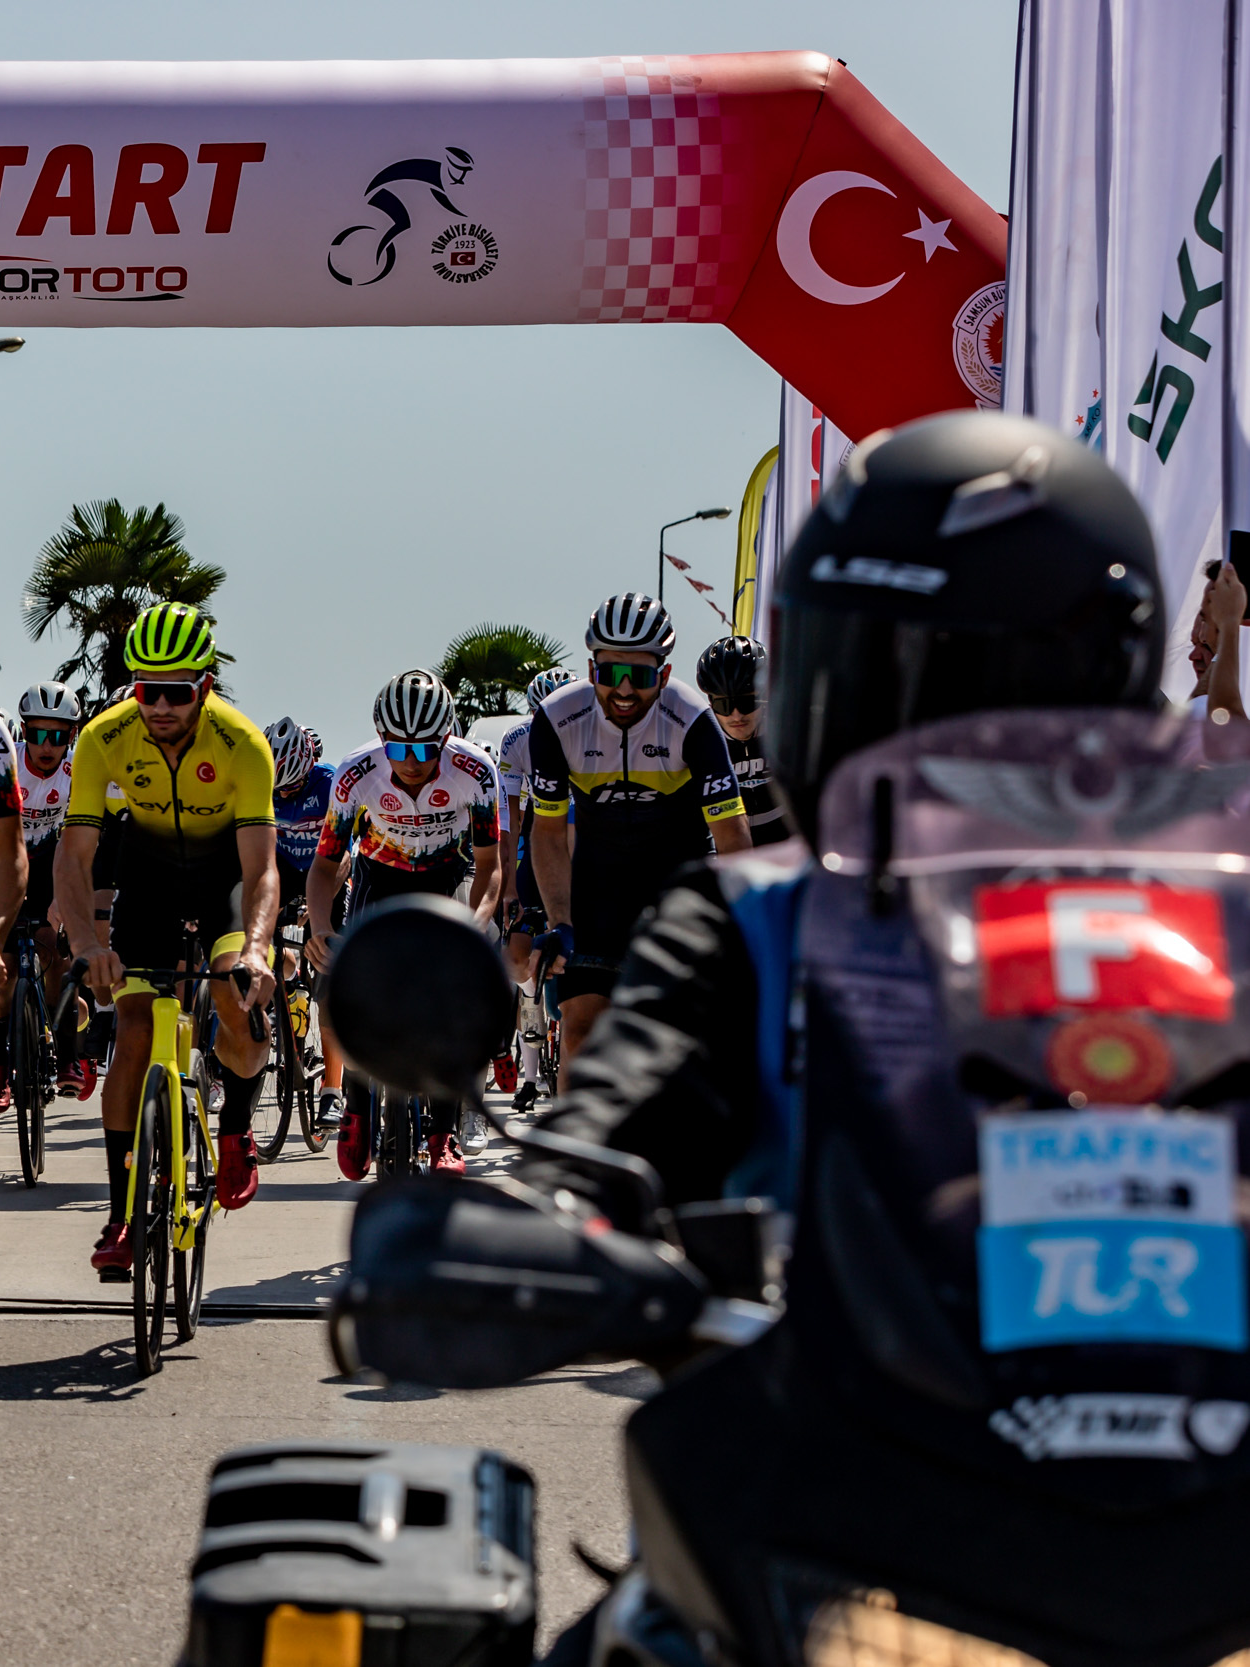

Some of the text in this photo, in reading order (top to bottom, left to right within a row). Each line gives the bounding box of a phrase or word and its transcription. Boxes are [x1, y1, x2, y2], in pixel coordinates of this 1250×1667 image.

[454, 240, 476, 249] 1923
[432, 260, 497, 284] FEDERASYONU
[963, 294, 993, 327] SAMSUN
[702, 774, 732, 797] iss
[377, 810, 459, 827] GEBIZ
[995, 1128, 1222, 1169] TRAFFIC
